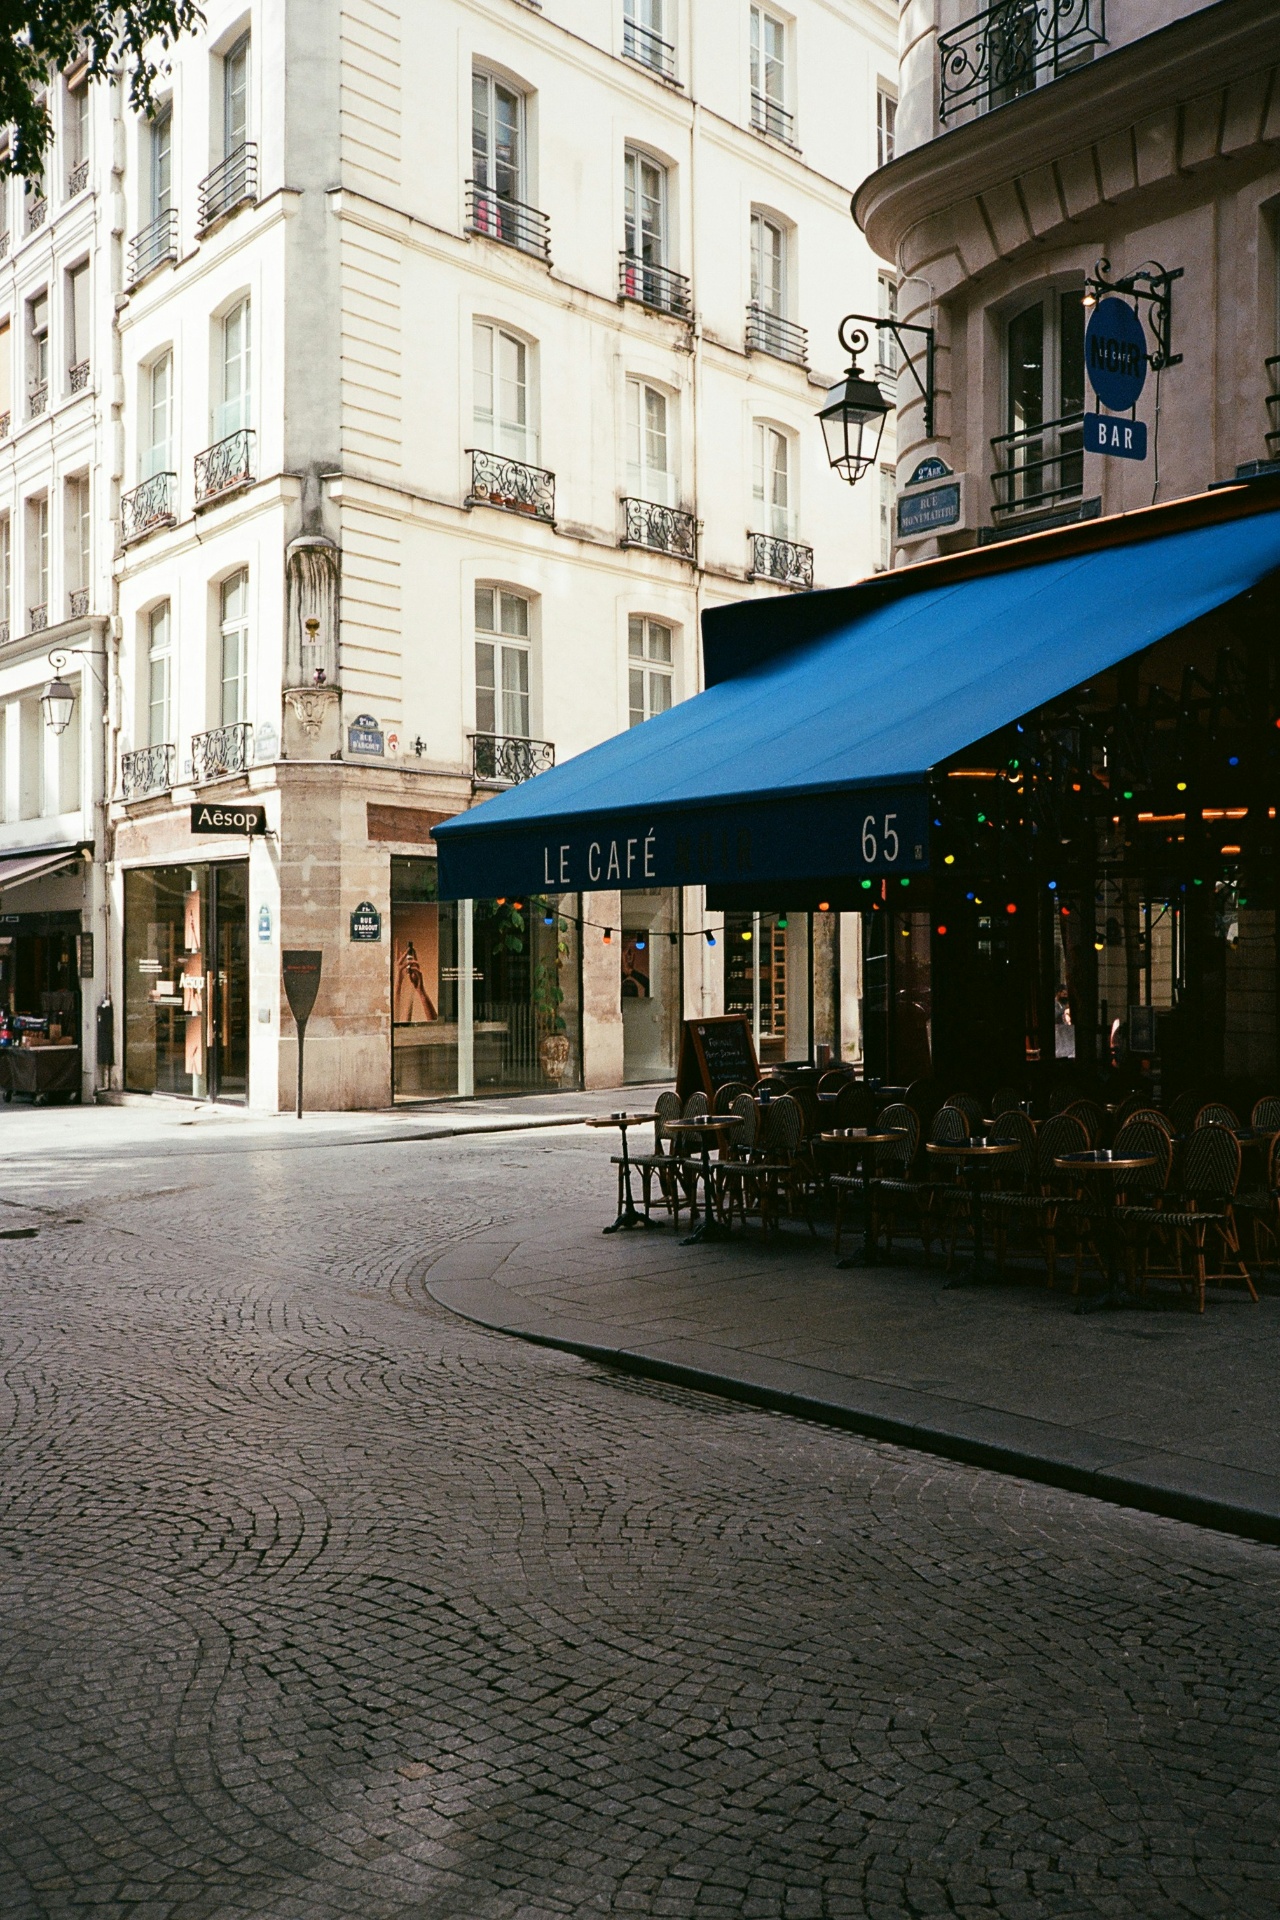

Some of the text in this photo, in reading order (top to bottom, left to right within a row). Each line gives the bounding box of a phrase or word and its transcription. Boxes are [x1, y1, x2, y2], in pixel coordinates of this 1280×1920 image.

[1091, 334, 1140, 378] NOIR
[1099, 348, 1108, 358] LE
[1098, 423, 1133, 449] BAR
[920, 496, 938, 509] RUE
[360, 733, 372, 742] RUE
[198, 808, 257, 832] Aēsop
[862, 813, 899, 863] 65
[544, 827, 752, 884] LE CAFÉ NOIR
